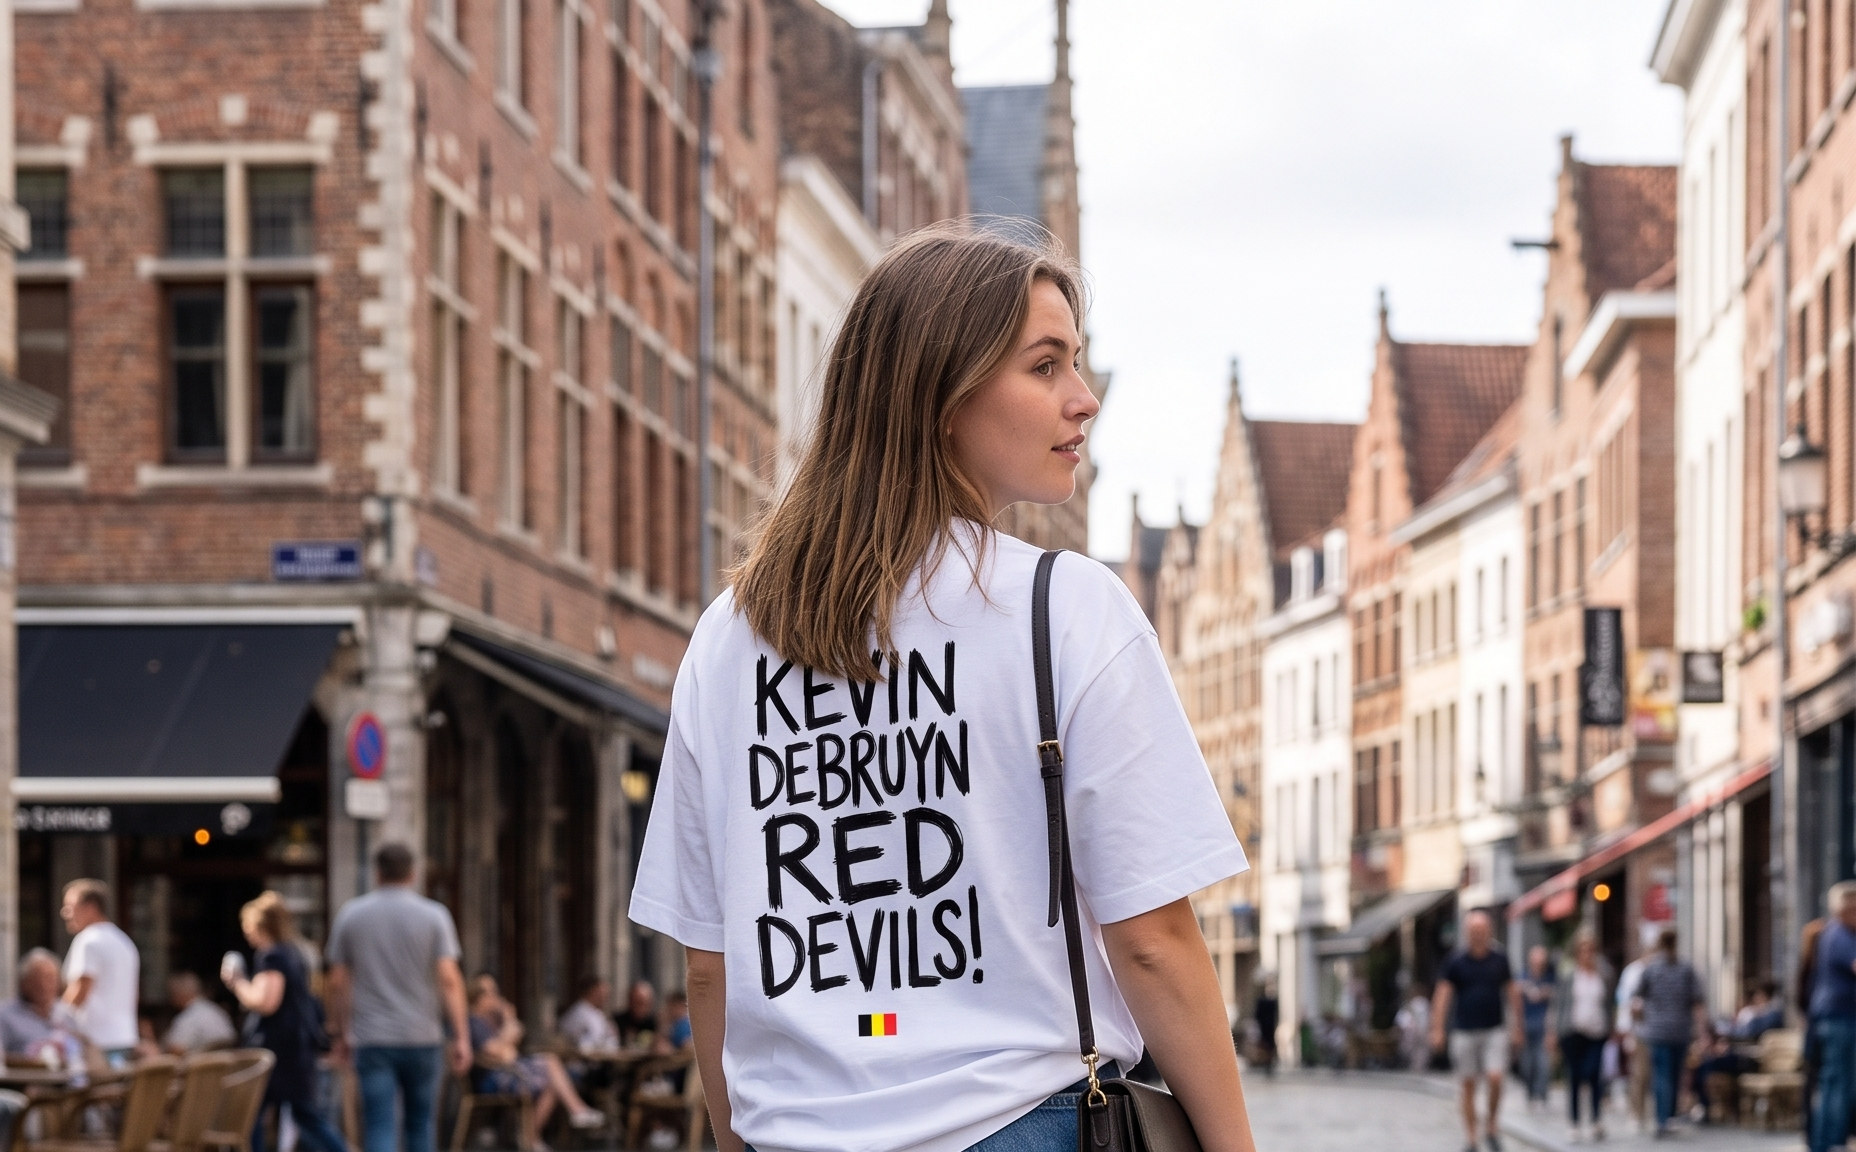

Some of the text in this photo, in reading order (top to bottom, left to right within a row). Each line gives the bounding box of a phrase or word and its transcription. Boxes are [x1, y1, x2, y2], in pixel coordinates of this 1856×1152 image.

[755, 641, 956, 740] KEVIN
[748, 719, 970, 810] DEBRUYN
[762, 807, 963, 912] RED
[756, 885, 984, 999] DEVILS!
